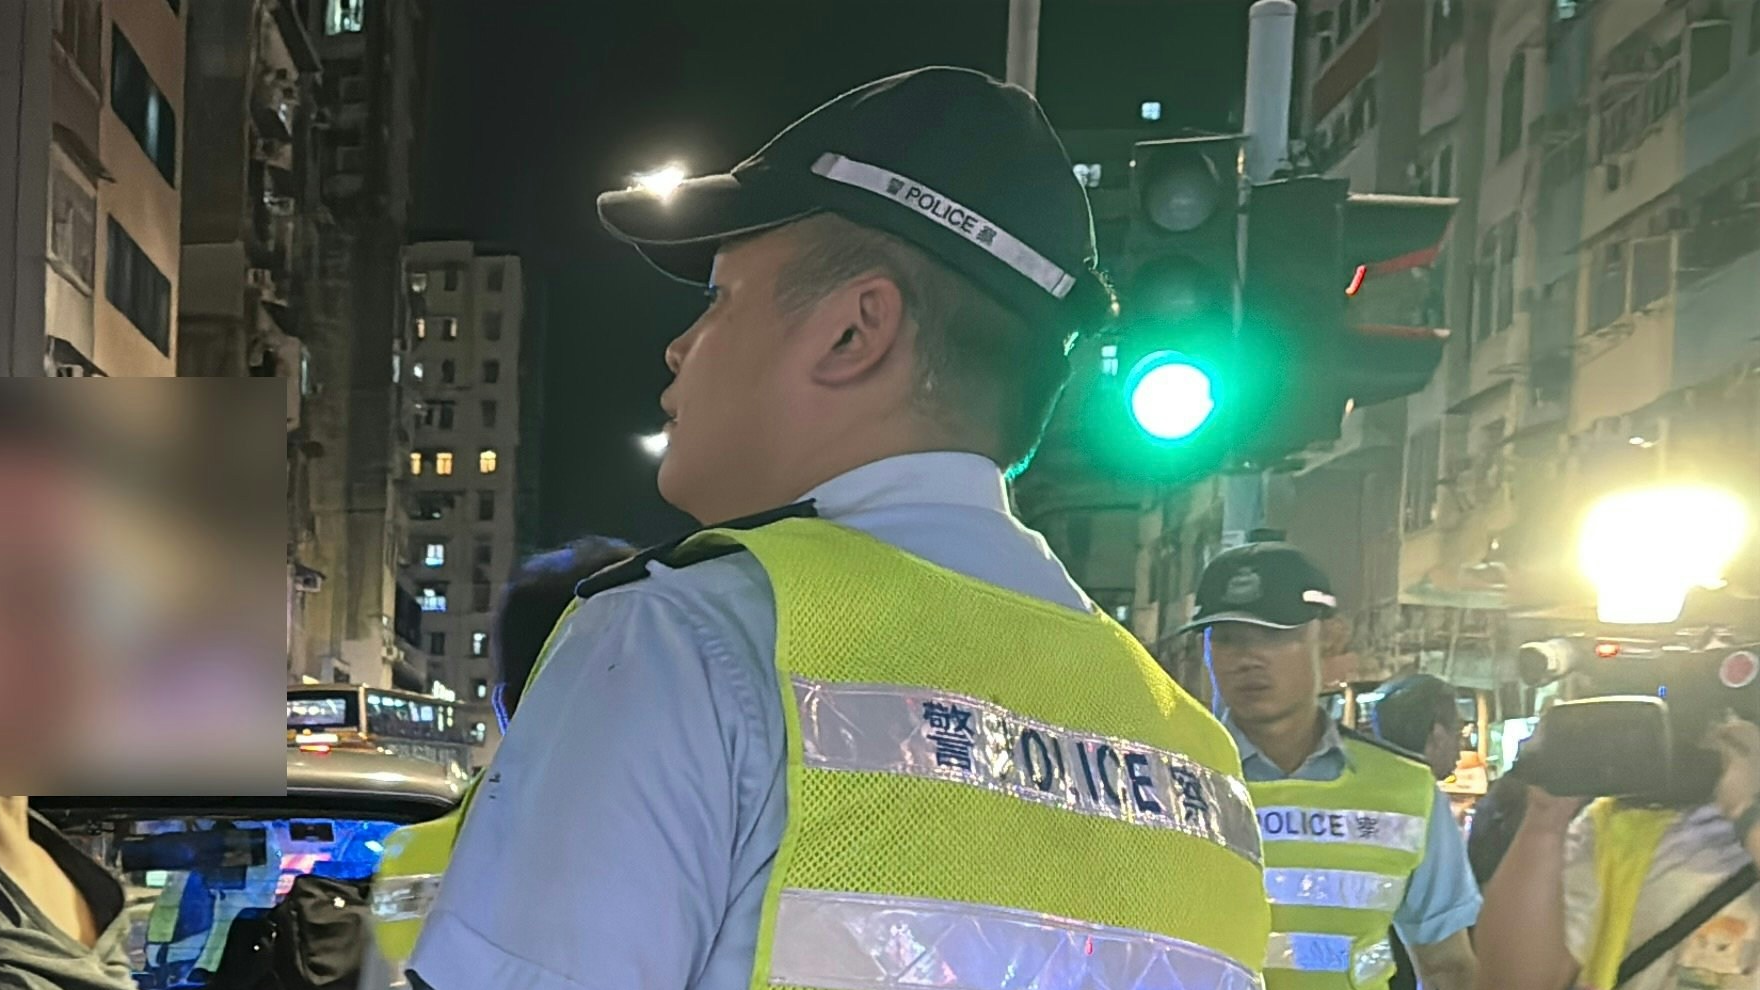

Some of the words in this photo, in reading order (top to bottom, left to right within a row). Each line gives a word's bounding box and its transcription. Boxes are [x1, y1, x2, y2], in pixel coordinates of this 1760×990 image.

[905, 186, 979, 235] POLICE
[921, 701, 975, 772] 警
[990, 712, 1162, 814] OLICE
